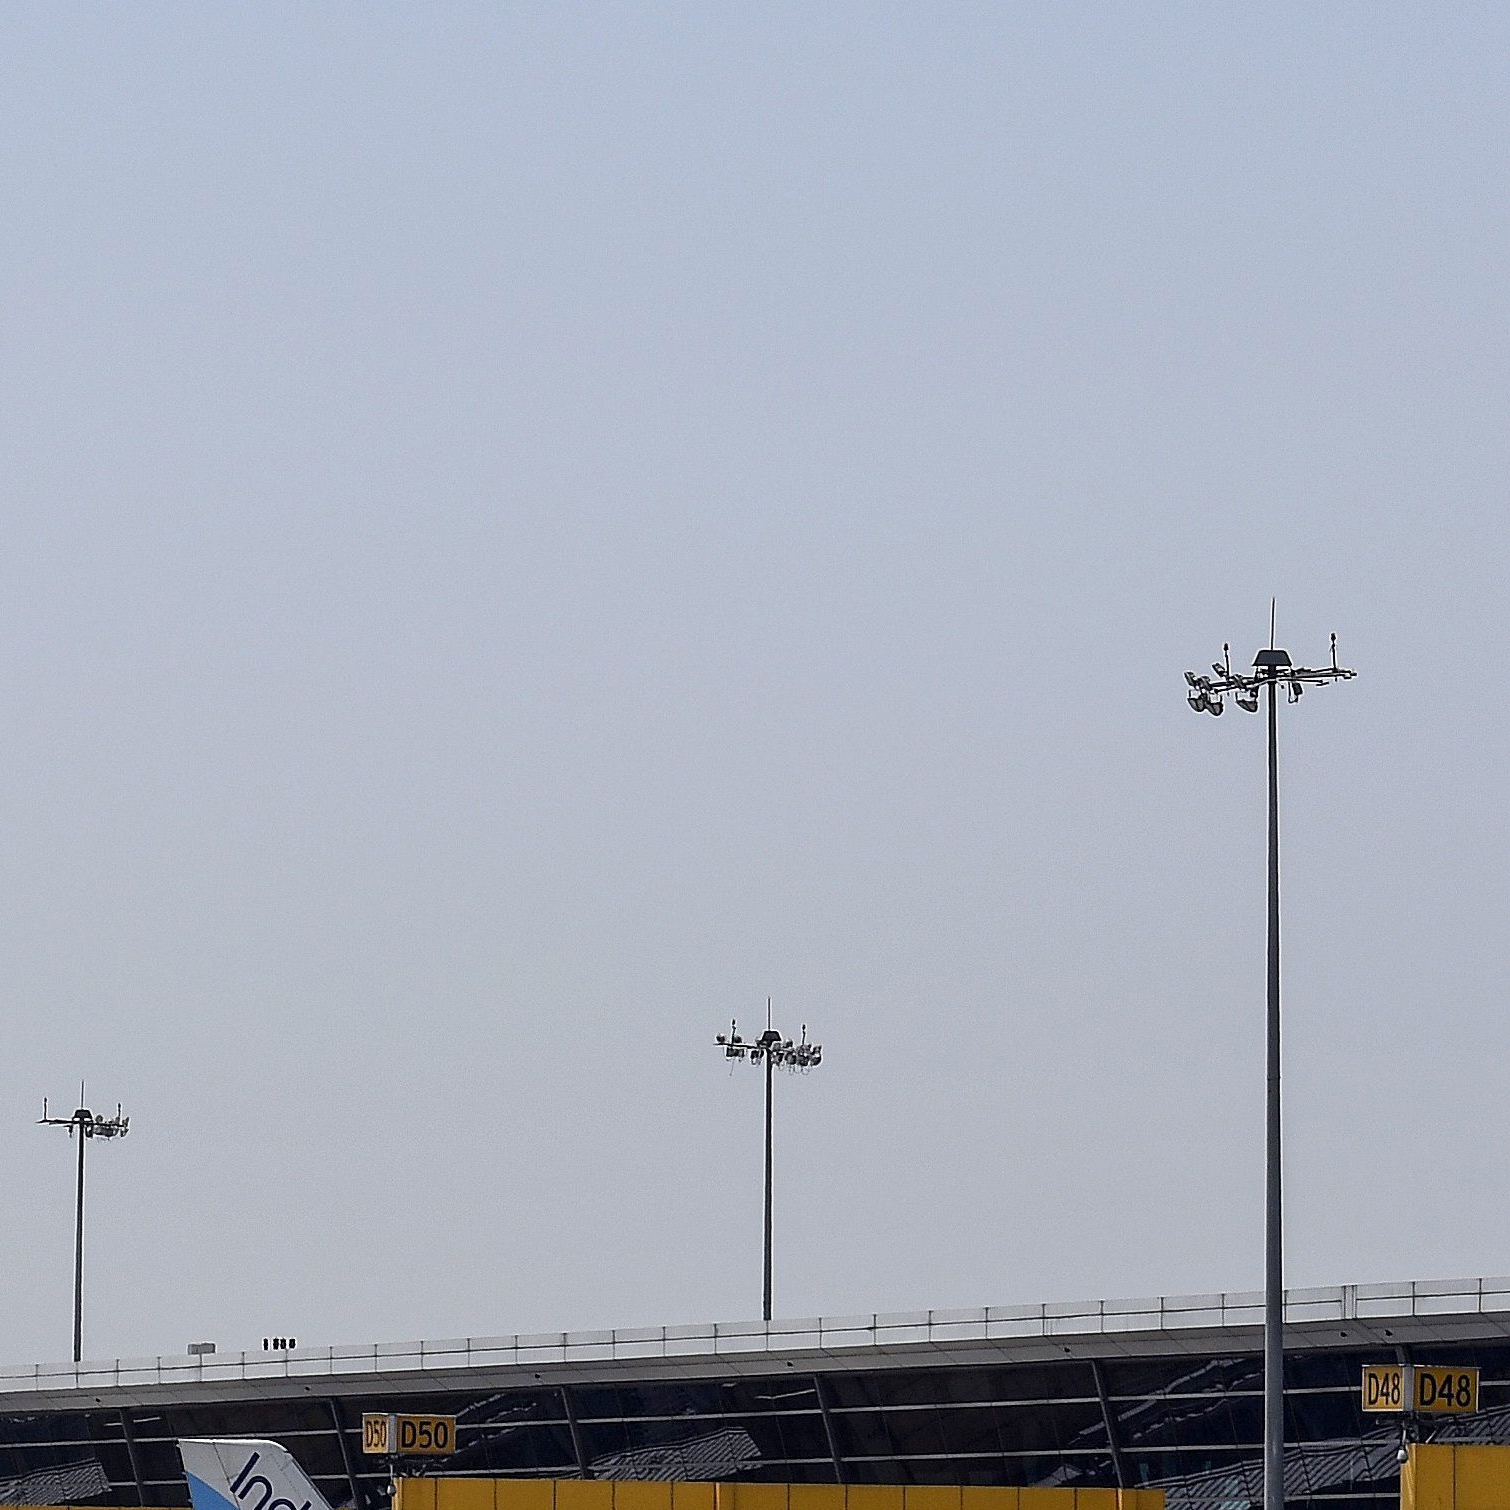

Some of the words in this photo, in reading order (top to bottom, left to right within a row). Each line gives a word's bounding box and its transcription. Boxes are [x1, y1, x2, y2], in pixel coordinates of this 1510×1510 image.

[1368, 1372, 1401, 1405] D48
[1419, 1373, 1471, 1407] D48
[366, 1420, 387, 1447] D50
[401, 1420, 448, 1449] D50
